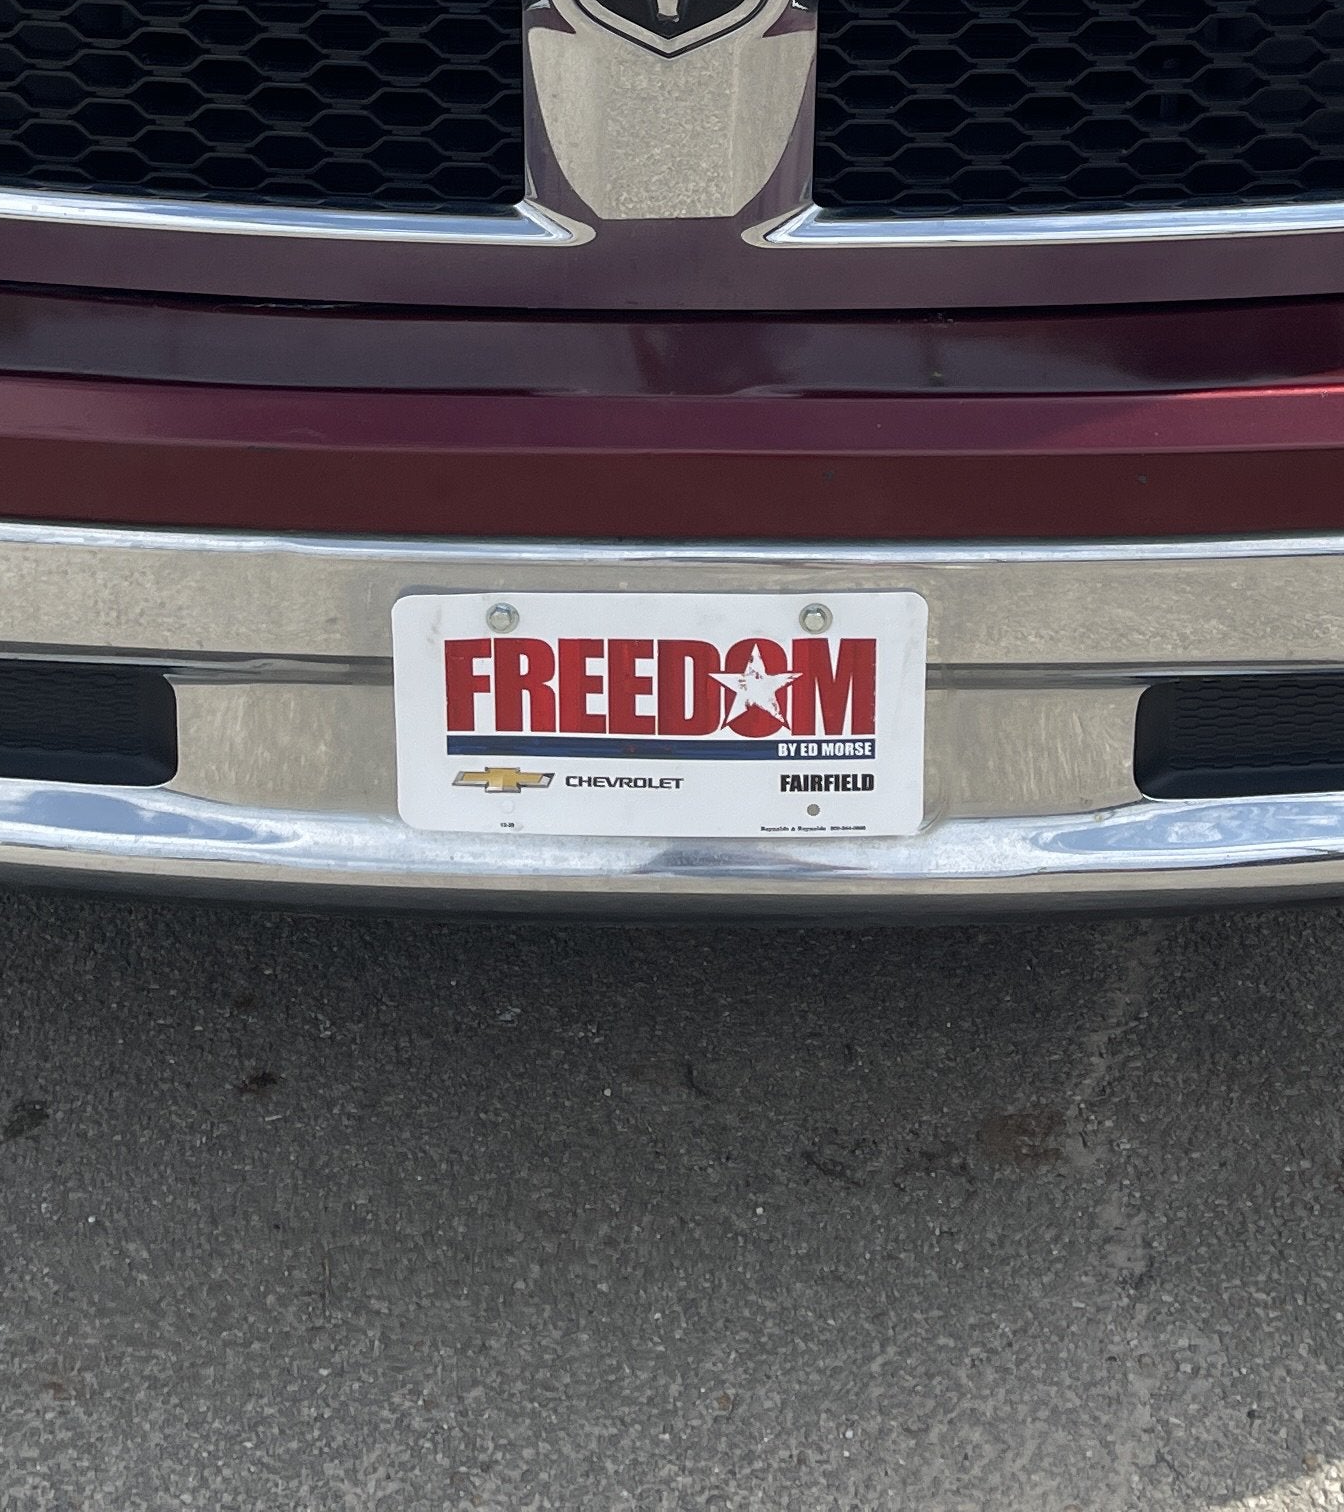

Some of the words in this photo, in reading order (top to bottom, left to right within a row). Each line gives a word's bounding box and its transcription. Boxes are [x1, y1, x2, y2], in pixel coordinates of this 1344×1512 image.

[444, 638, 877, 738] FREEDOM
[778, 743, 797, 757] BY
[800, 743, 818, 757] ED
[821, 742, 872, 756] MORSE
[565, 776, 684, 789] CHEVROLET
[780, 773, 875, 793] FAIRFIELD
